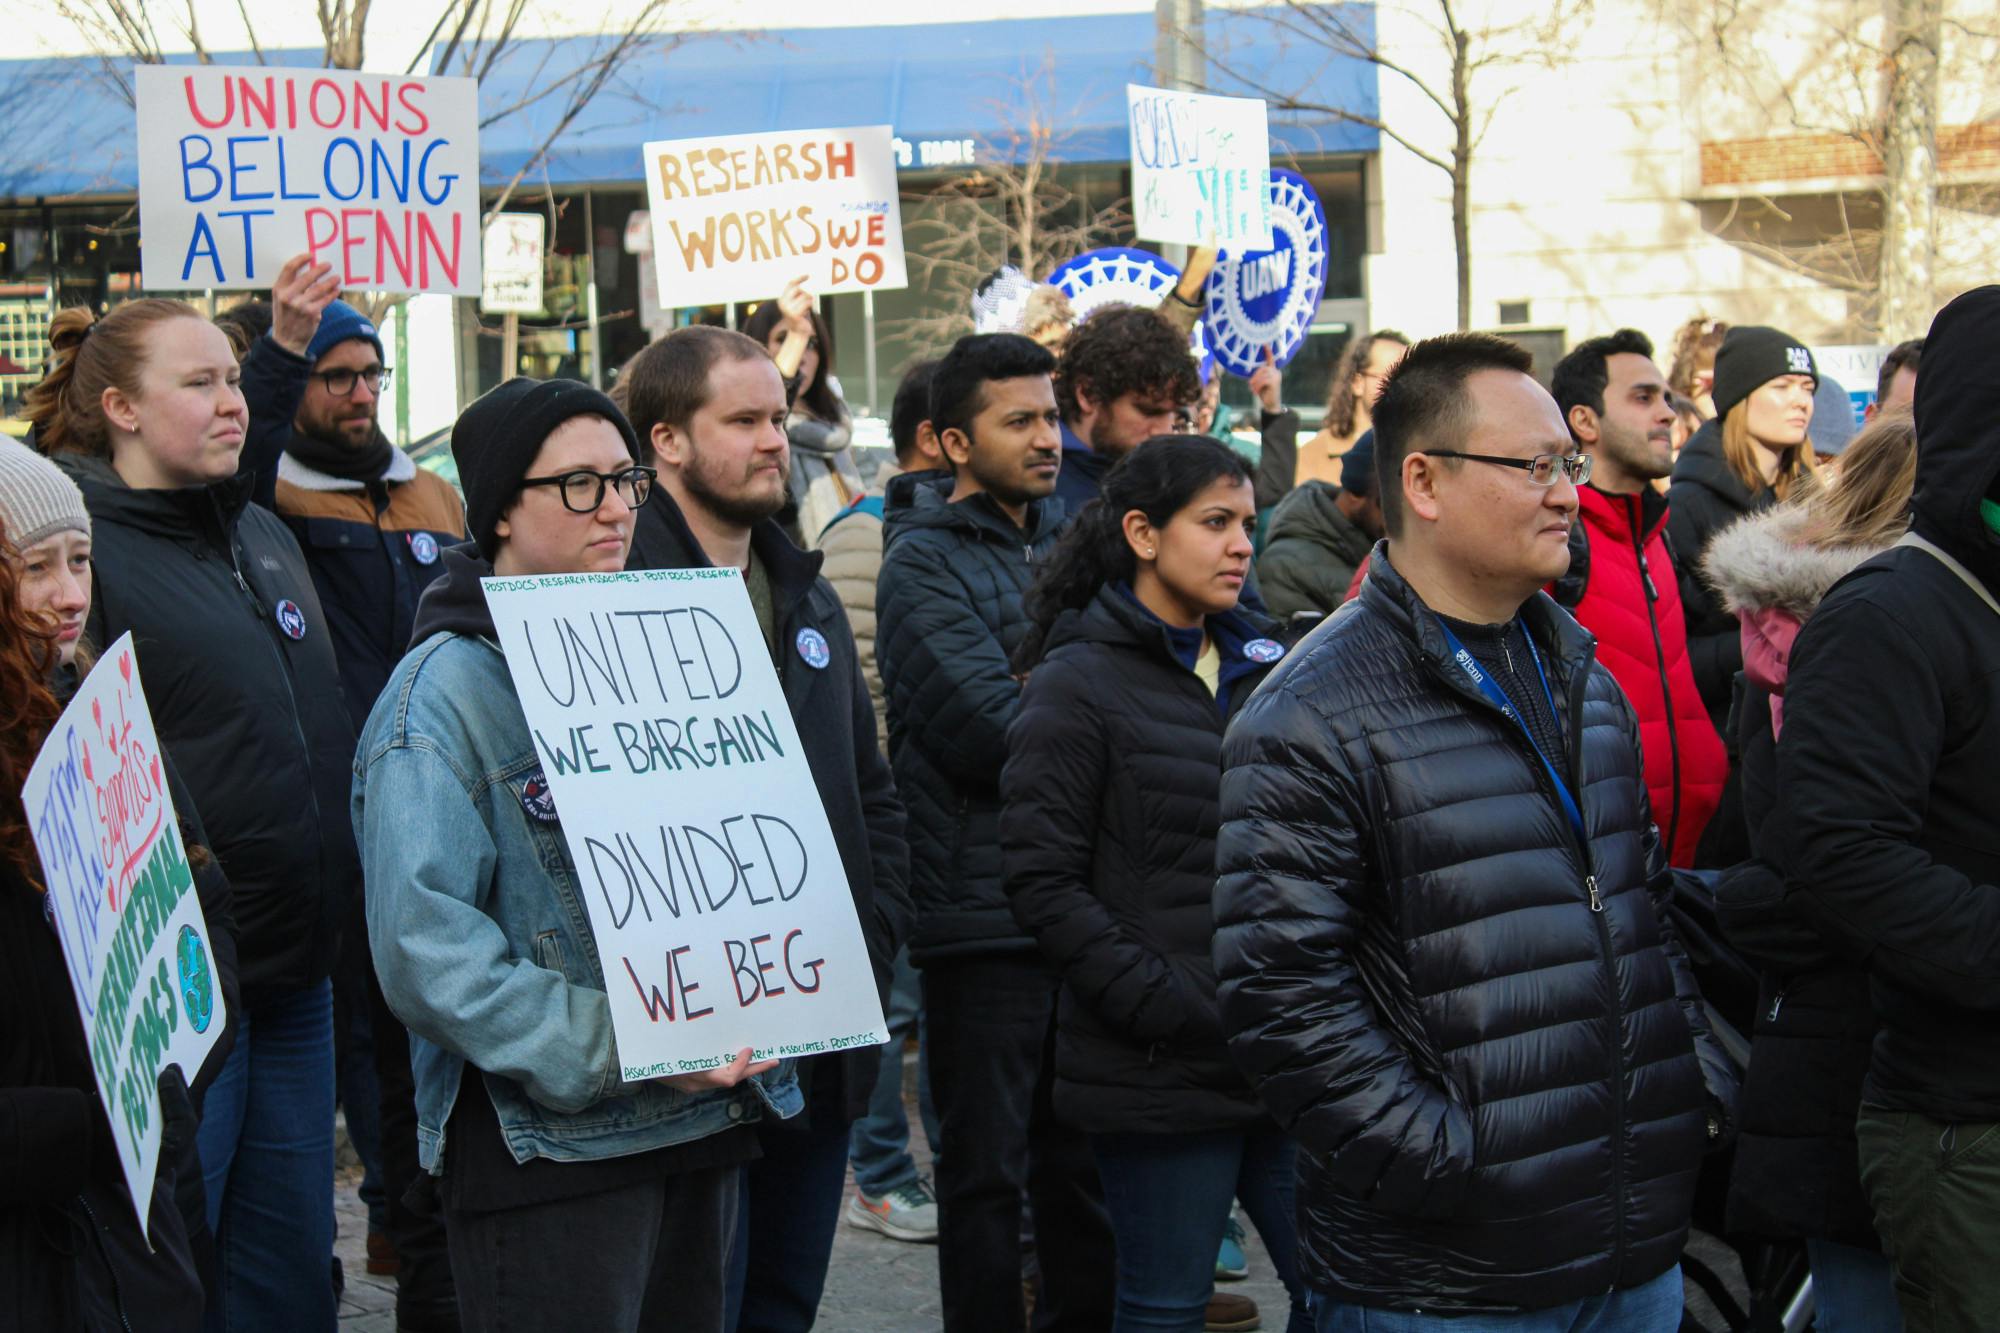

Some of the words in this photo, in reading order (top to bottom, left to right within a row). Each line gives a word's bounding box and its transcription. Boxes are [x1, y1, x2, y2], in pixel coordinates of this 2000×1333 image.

[183, 75, 429, 135] UNIONS
[180, 134, 459, 205] BELONG
[658, 141, 856, 200] RESEARSH
[181, 209, 274, 282] AT
[305, 207, 462, 289] PENN
[669, 206, 821, 272] WORKS
[827, 215, 885, 250] WE
[831, 251, 885, 285] DO
[1242, 248, 1292, 302] UAW
[485, 577, 537, 592] POSTDOCS
[539, 574, 587, 588] RESEARCH
[588, 572, 640, 584] ASSOCIATES
[646, 570, 692, 582] POSTDOCS
[696, 568, 738, 579] RESEARCH
[524, 606, 742, 708] UNITED
[1464, 657, 1484, 684] Penn
[534, 724, 611, 776] WE
[614, 710, 785, 774] BARGAIN
[584, 814, 808, 929] DIVIDED
[94, 822, 192, 1117] INTERNATIONAL
[622, 945, 714, 1022] WE
[724, 929, 825, 1008] BEG
[121, 957, 178, 1170] POSTDOCS
[624, 1062, 674, 1080] ASSOCIATES
[678, 1057, 720, 1071] POSTDOCS
[725, 1047, 774, 1064] REARCH
[779, 1041, 825, 1055] ASSOCIATES
[830, 1032, 880, 1049] POSTDOCS
